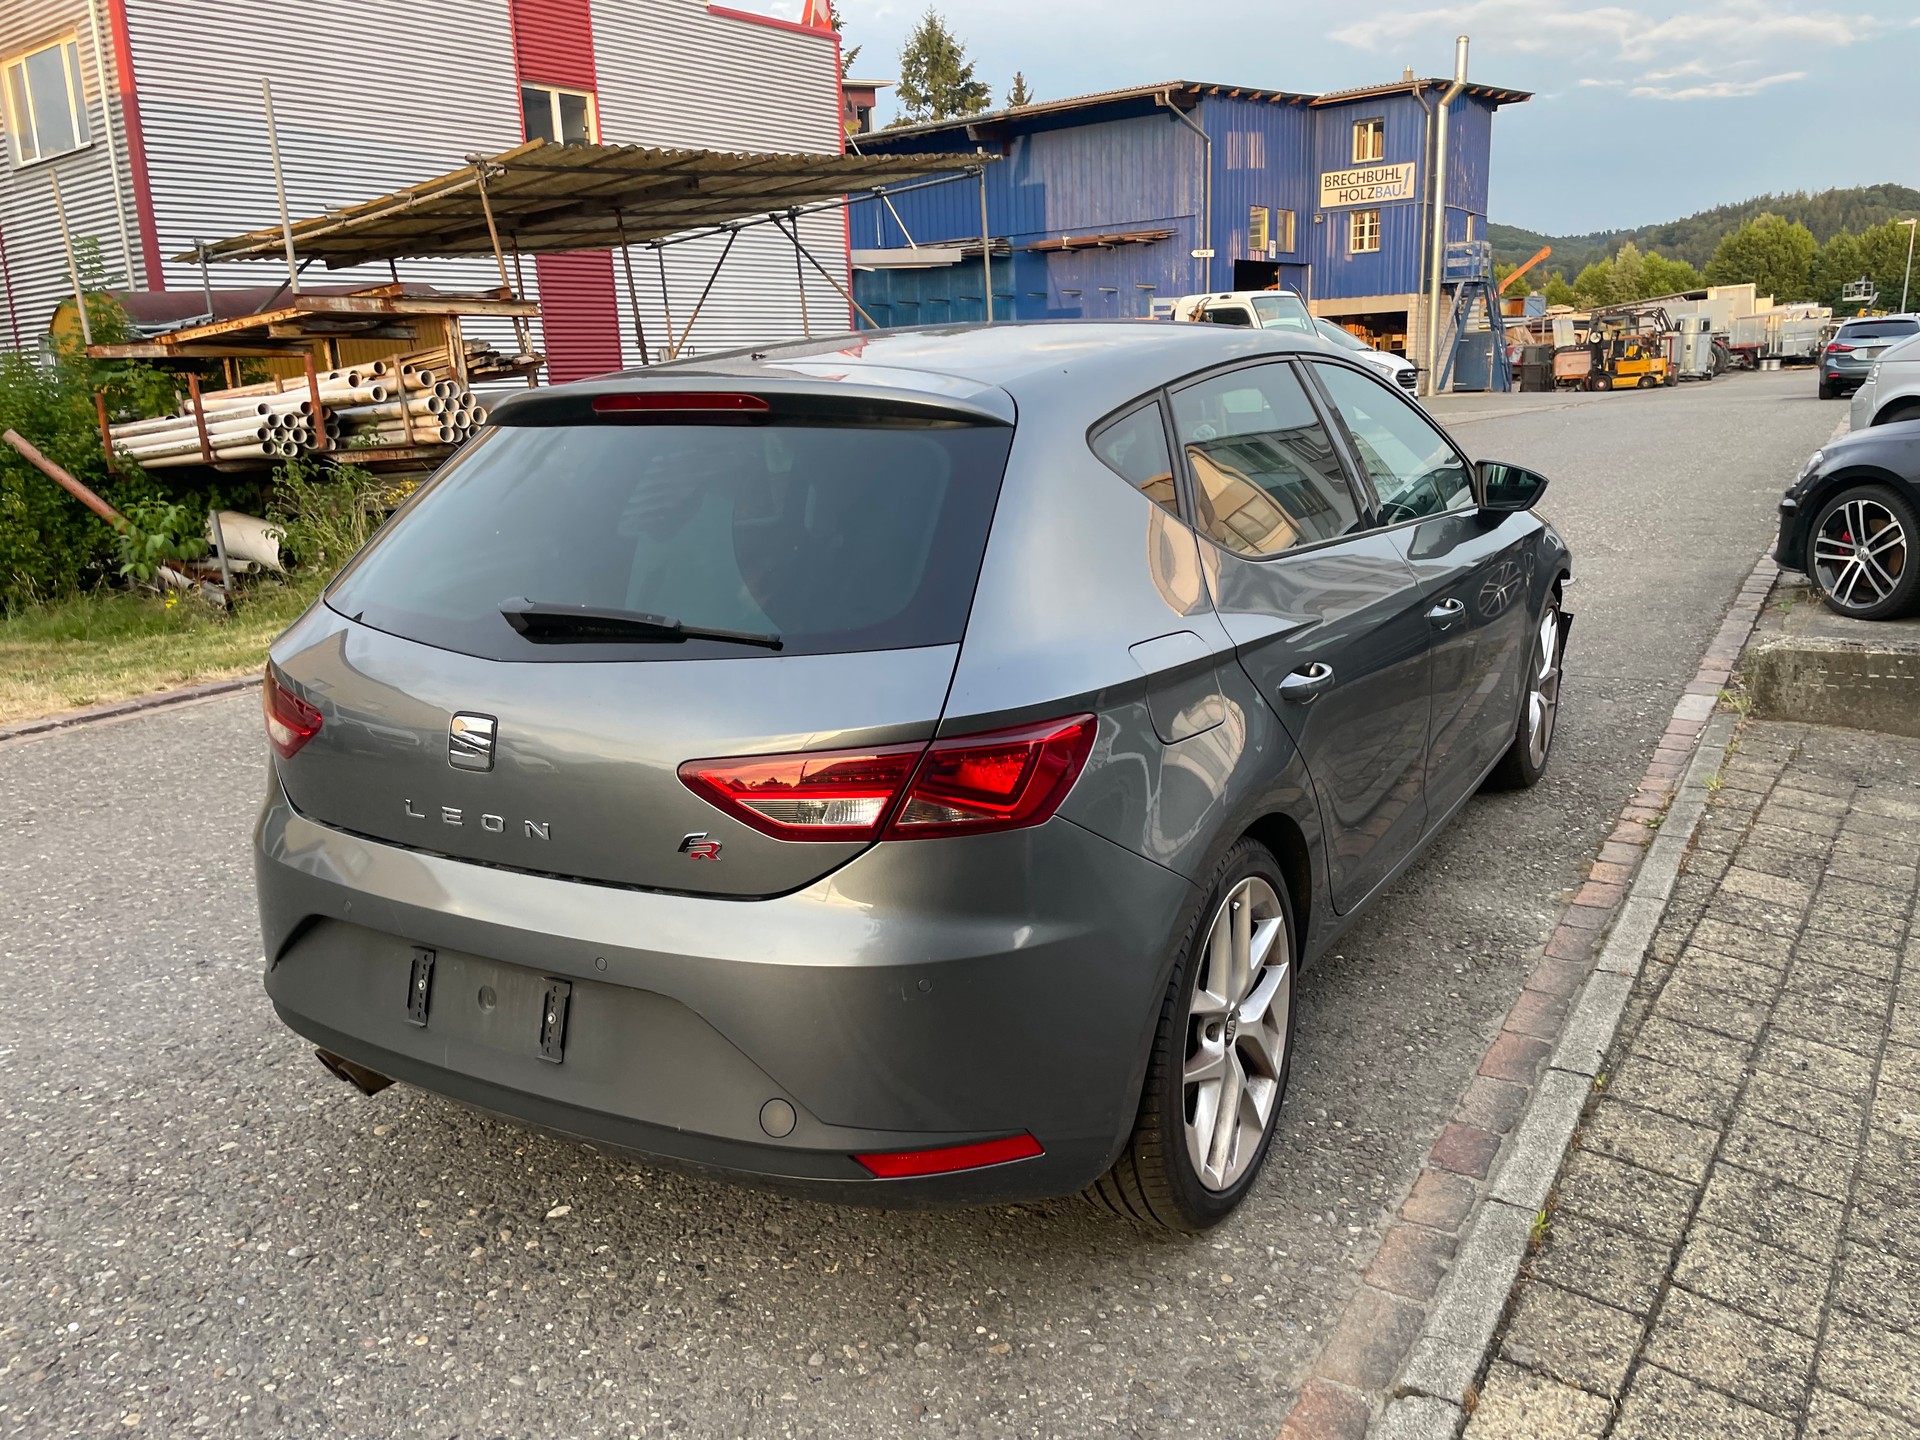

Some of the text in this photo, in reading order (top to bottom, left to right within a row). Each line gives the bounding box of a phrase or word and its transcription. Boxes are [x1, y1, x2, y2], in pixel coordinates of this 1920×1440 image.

[1324, 168, 1402, 187] BRECHBÜHL
[404, 799, 551, 841] LEON
[677, 832, 723, 862] FR
